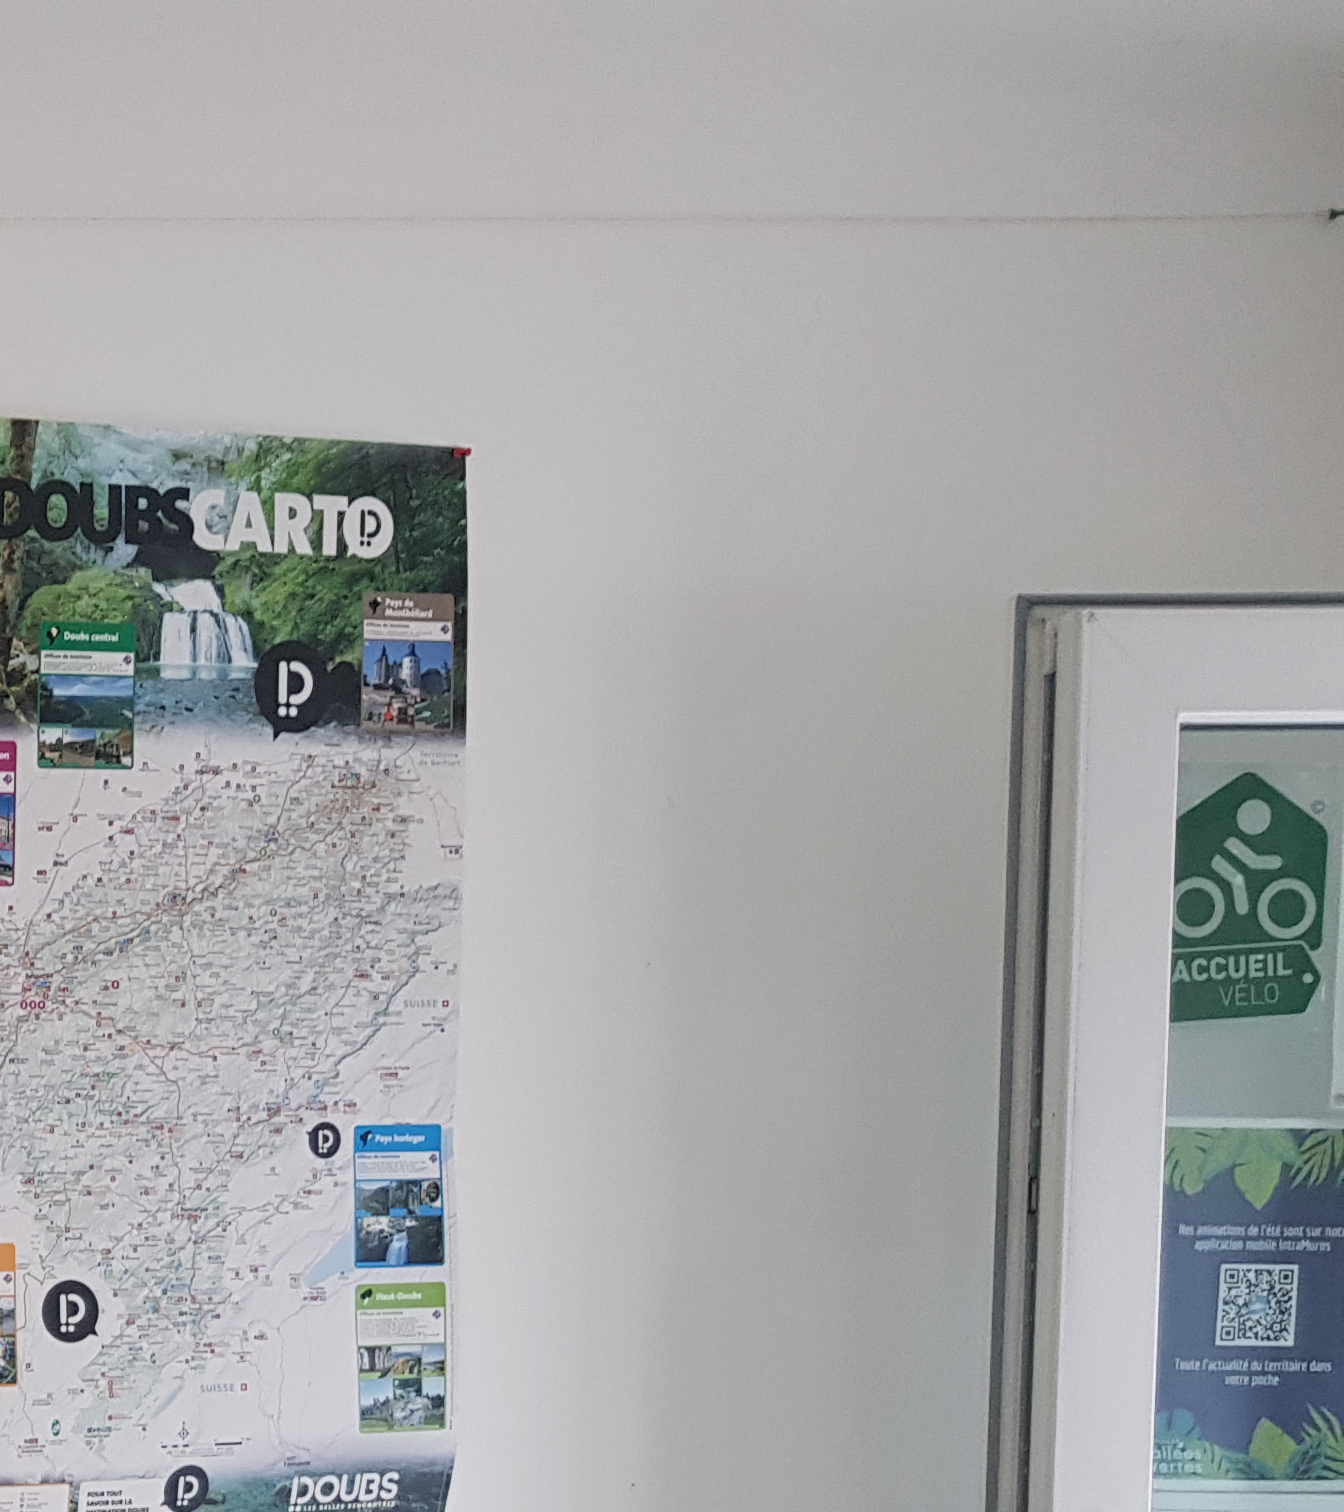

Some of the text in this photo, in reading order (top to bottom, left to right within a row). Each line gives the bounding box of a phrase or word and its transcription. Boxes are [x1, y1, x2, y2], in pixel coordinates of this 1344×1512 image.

[64, 631, 119, 643] Doubs central
[1172, 953, 1292, 983] ACCUEIL
[1220, 981, 1279, 1006] VÉLO
[200, 1383, 235, 1392] SUISSE
[288, 1471, 400, 1507] DOUBS
